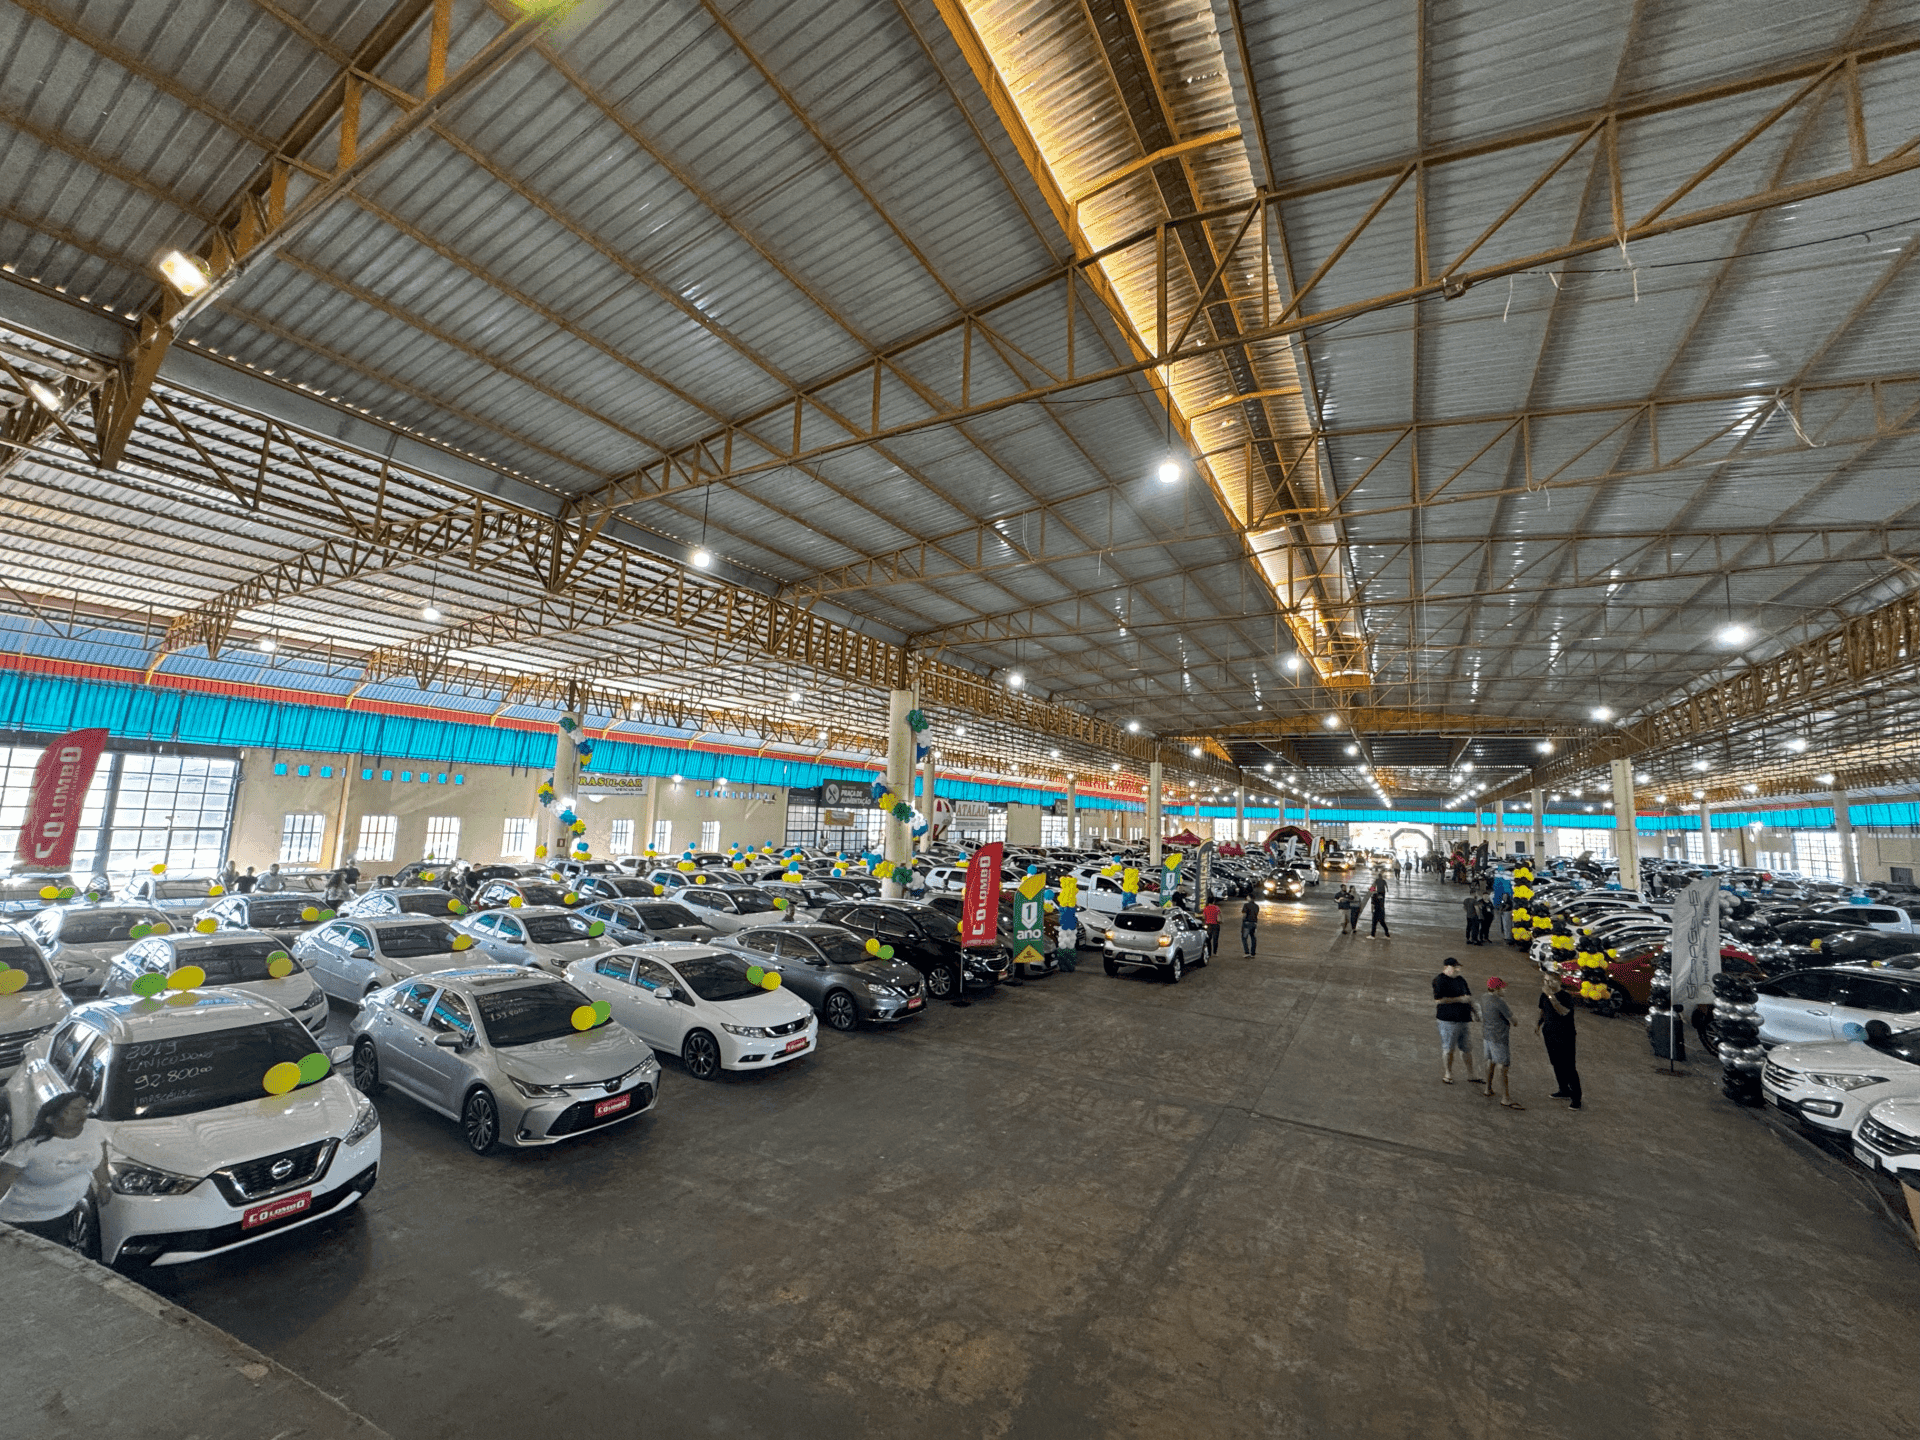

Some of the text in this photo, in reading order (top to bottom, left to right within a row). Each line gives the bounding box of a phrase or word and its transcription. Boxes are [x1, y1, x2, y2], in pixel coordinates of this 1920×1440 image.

[578, 776, 642, 787] RASILCAR
[34, 746, 82, 859] COLOMBO
[956, 803, 988, 817] ATALAIA
[972, 855, 991, 935] COLOMBO
[1026, 904, 1032, 920] 1
[1016, 928, 1042, 940] ano
[125, 1040, 178, 1060] 2019
[249, 1200, 305, 1222] COLOMBO
